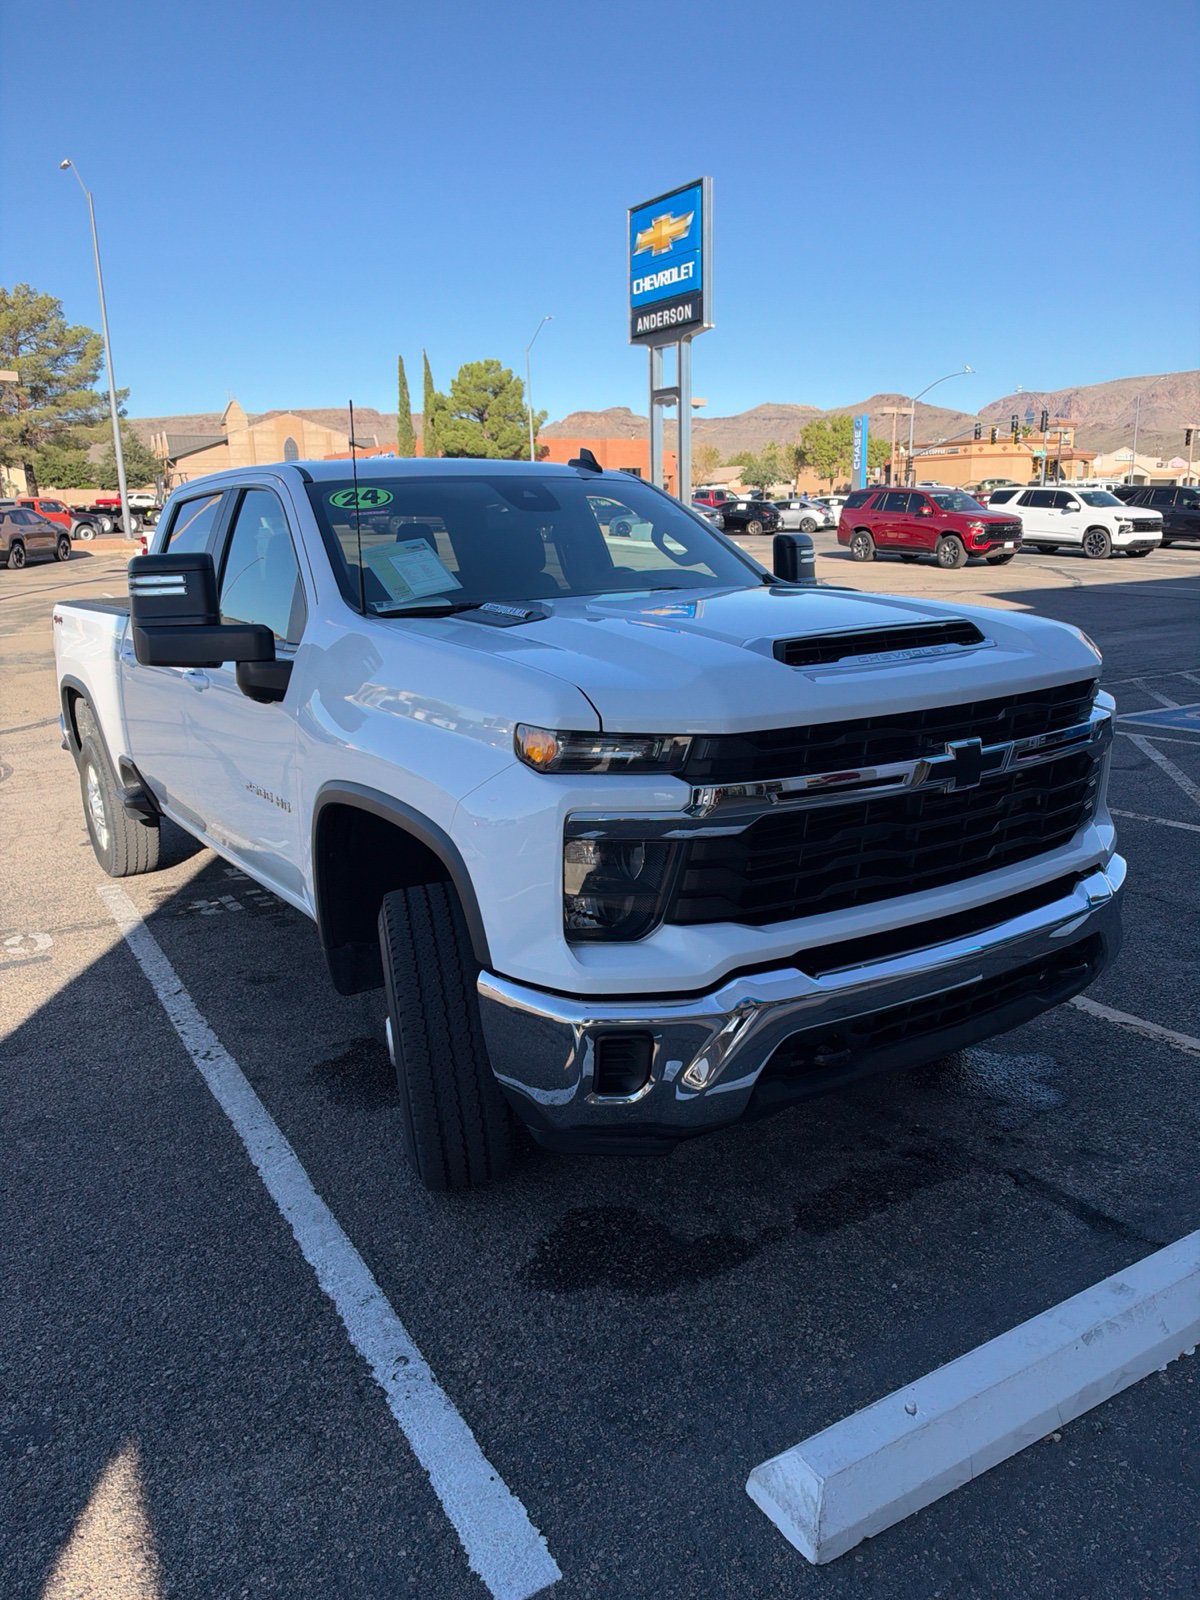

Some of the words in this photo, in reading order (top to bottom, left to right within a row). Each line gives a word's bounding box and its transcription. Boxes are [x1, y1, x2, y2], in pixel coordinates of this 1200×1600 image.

[633, 261, 695, 295] CHEVROLET
[637, 304, 692, 332] ANDERSON
[853, 430, 862, 470] CHASE
[341, 489, 381, 506] 24
[857, 646, 948, 663] CHEVROLET
